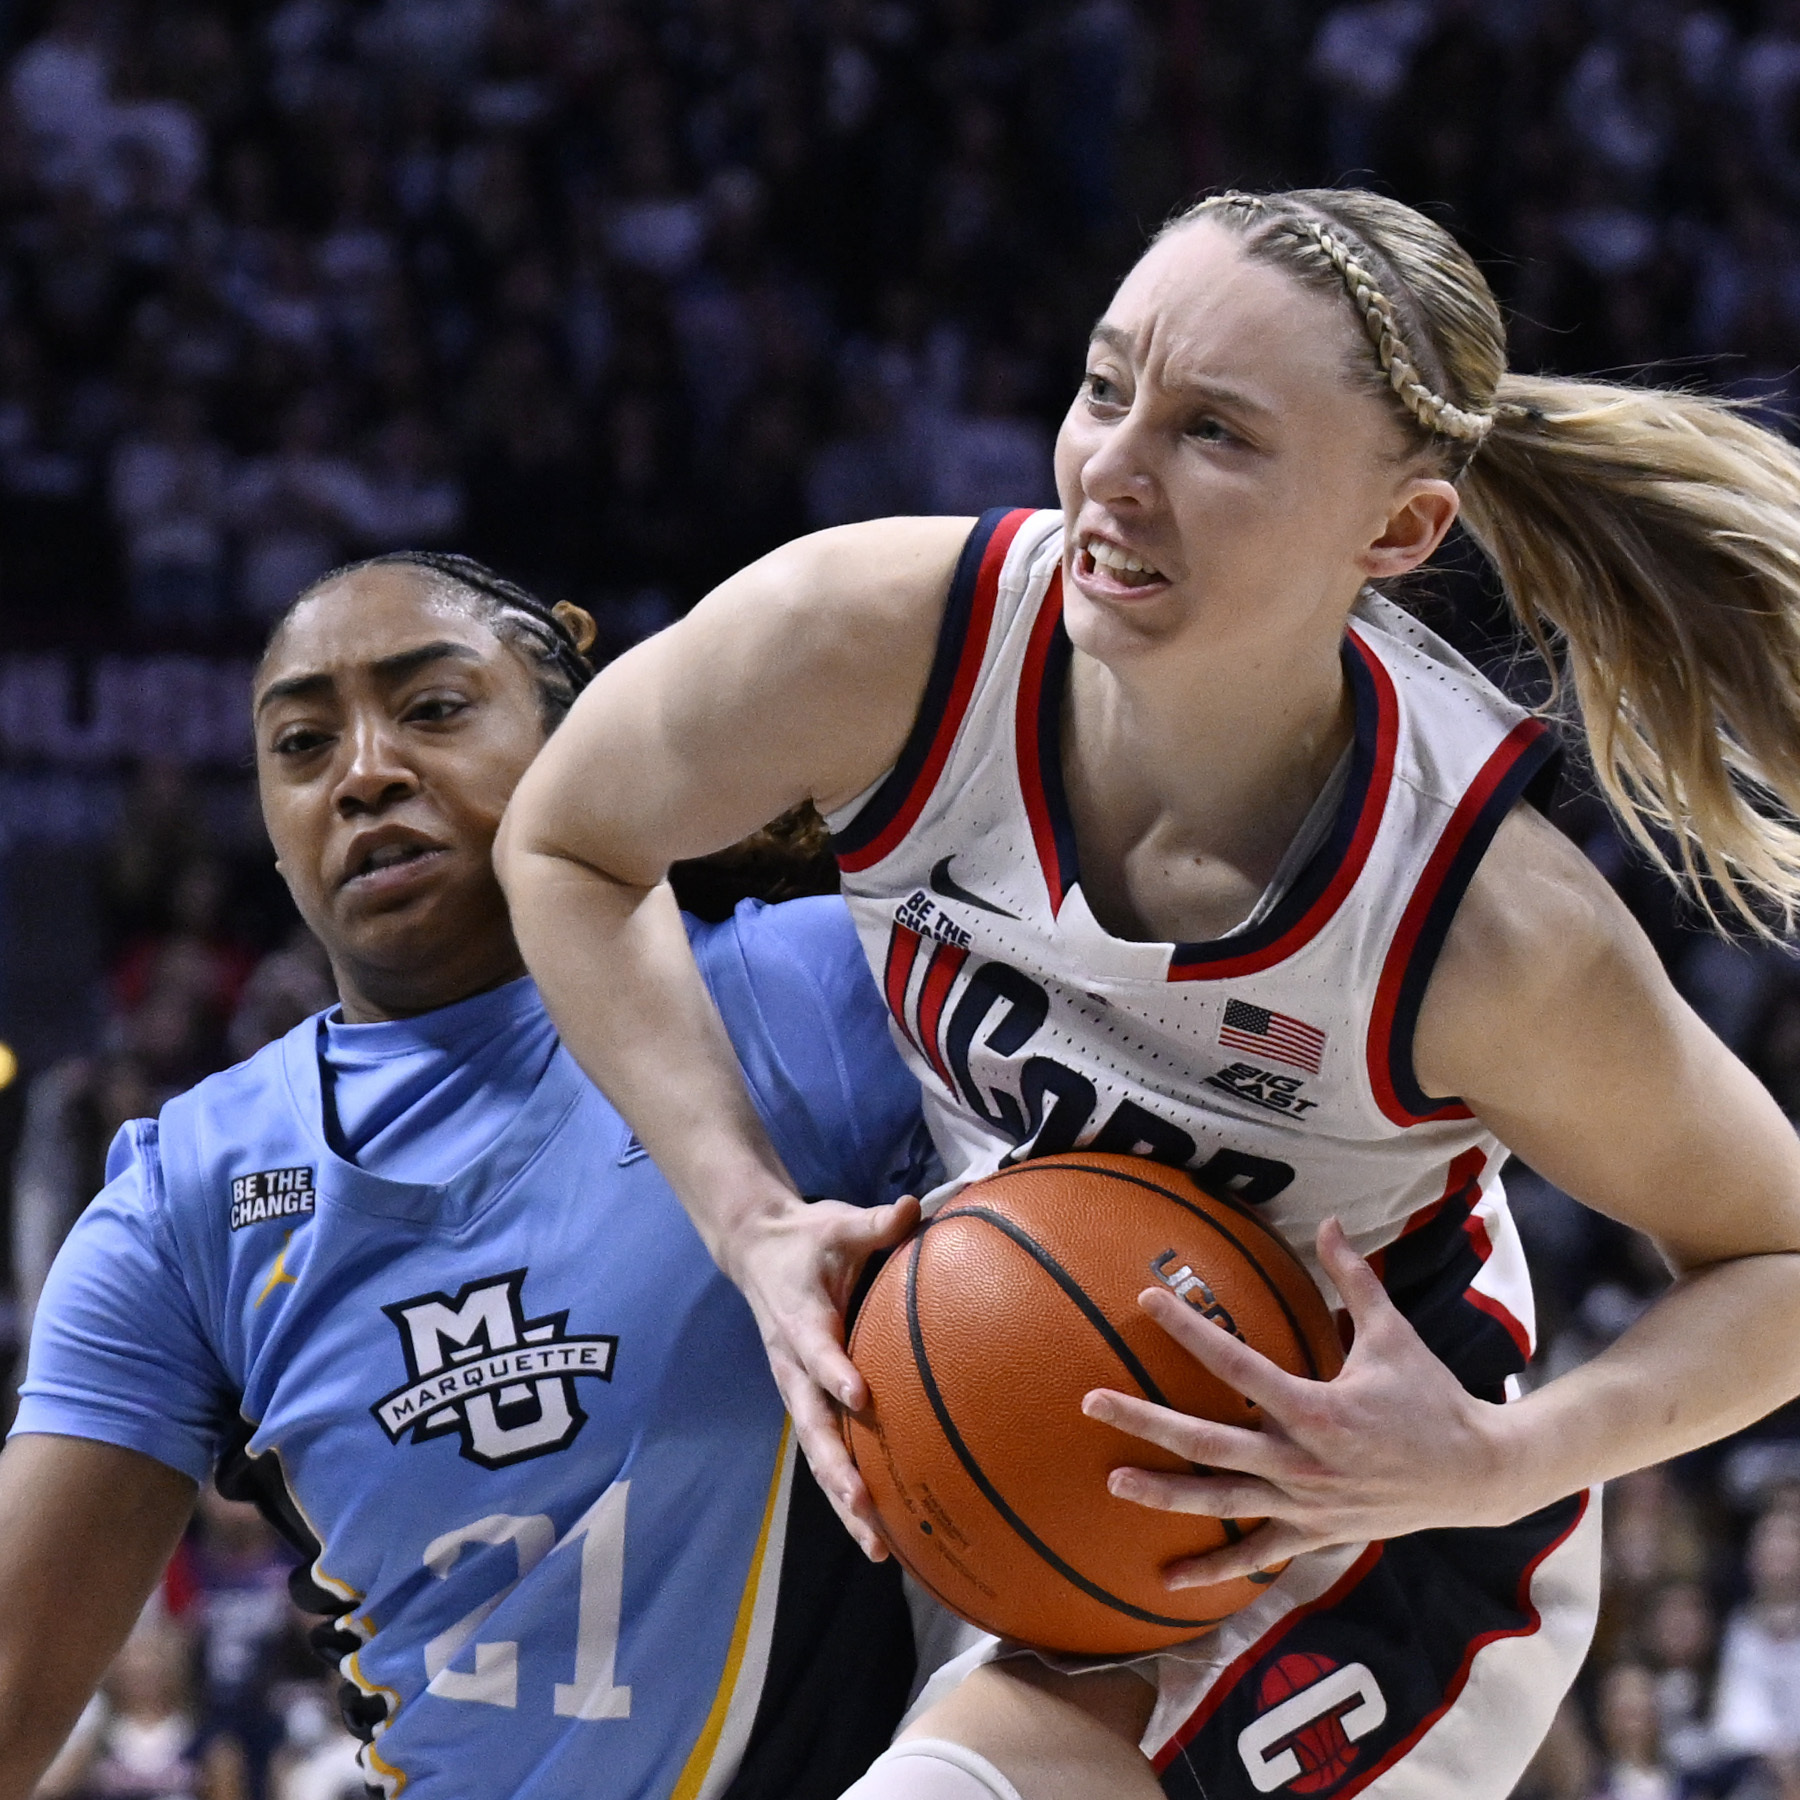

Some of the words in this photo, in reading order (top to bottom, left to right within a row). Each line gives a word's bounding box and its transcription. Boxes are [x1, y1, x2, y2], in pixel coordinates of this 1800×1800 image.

[906, 890, 935, 921] BE
[935, 911, 972, 948] THE
[1216, 1069, 1318, 1113] EAST
[1229, 1062, 1304, 1093] BIG
[233, 1174, 257, 1203] BE
[264, 1169, 309, 1194] THE
[231, 1191, 314, 1229] CHANGE
[391, 1346, 598, 1421] MARQUETTE
[421, 1479, 632, 1720] 21
